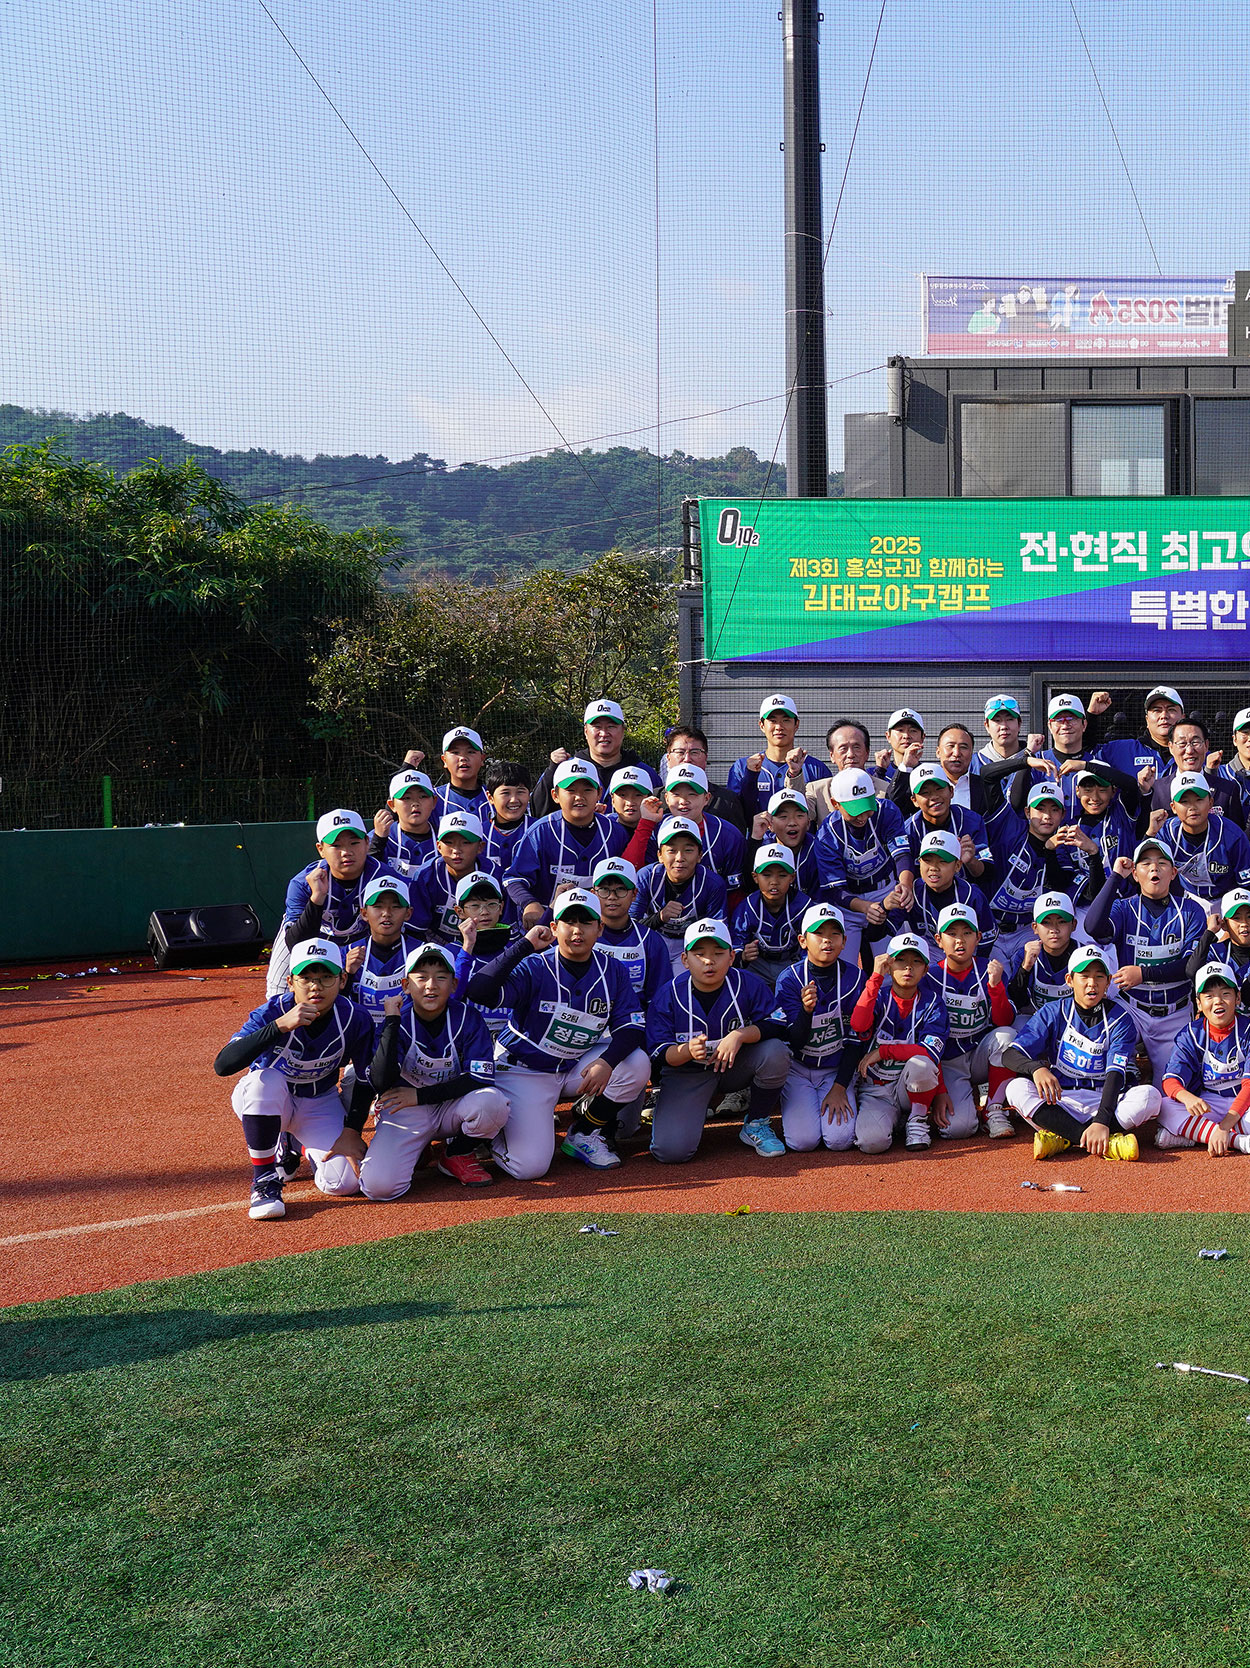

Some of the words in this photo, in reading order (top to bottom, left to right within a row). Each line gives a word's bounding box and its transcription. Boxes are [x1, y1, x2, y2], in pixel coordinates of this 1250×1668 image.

[870, 538, 921, 555] 2025
[1019, 532, 1147, 572] 전·현직
[789, 558, 839, 578] 제3회
[847, 558, 921, 578] 홍성군과
[928, 558, 1004, 578] 함께하는
[803, 583, 990, 612] 김태균야구캠프
[1129, 589, 1248, 630] 특별한
